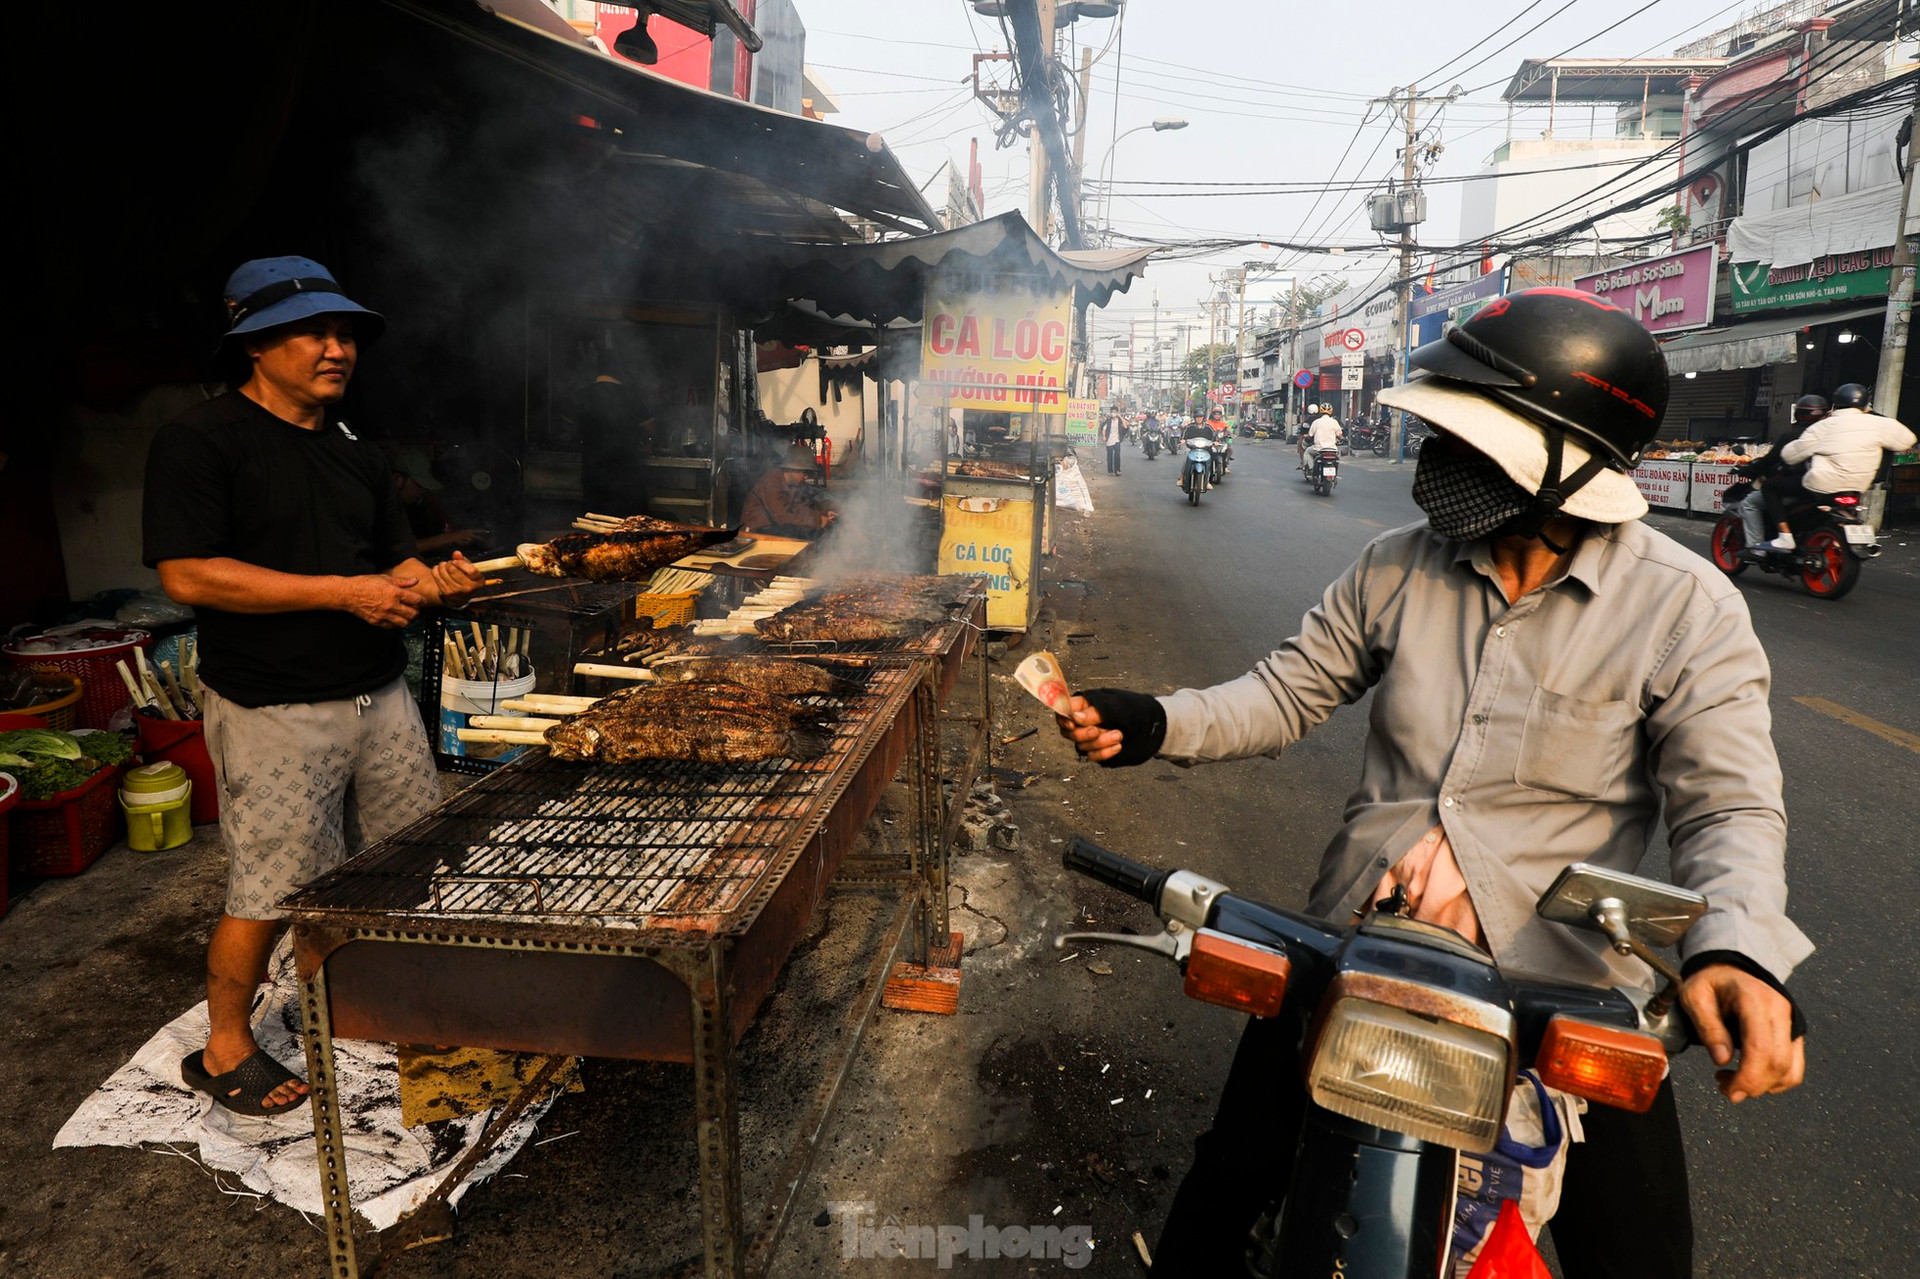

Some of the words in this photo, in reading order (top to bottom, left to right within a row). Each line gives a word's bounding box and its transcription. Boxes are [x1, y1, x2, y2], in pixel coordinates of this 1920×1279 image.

[1632, 270, 1641, 285] &
[1635, 285, 1685, 321] Mum
[931, 307, 981, 356] CÁ
[993, 311, 1065, 362] LÓC
[929, 365, 1008, 401] NƯỚNG
[1015, 370, 1059, 405] MÍA
[1695, 470, 1716, 484] BÁNH
[955, 541, 977, 561] CÁ
[982, 543, 1013, 563] LÓC
